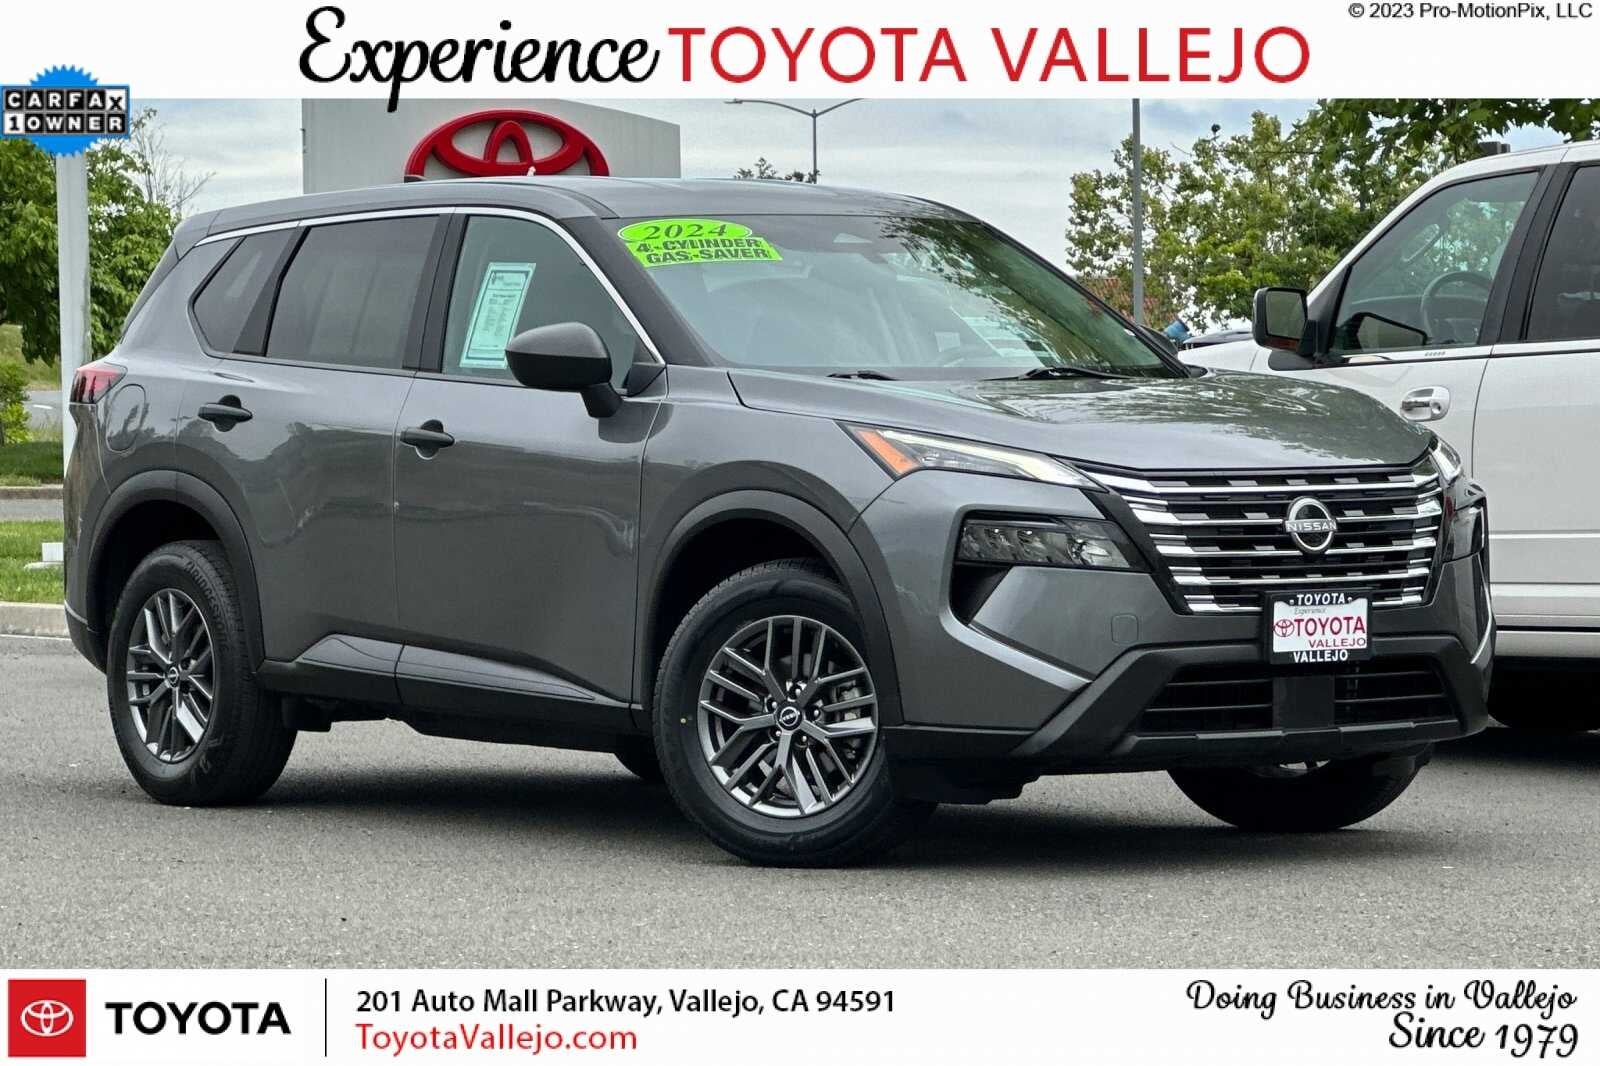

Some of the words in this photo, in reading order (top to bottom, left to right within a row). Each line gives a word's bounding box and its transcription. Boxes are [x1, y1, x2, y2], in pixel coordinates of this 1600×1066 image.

[644, 223, 728, 240] 2024
[1286, 521, 1338, 532] NISSAN
[1296, 592, 1346, 606] TOYOTA
[1294, 616, 1365, 637] TOYOTA
[1308, 637, 1366, 649] VALLEJO
[1293, 649, 1349, 663] VALLEJO
